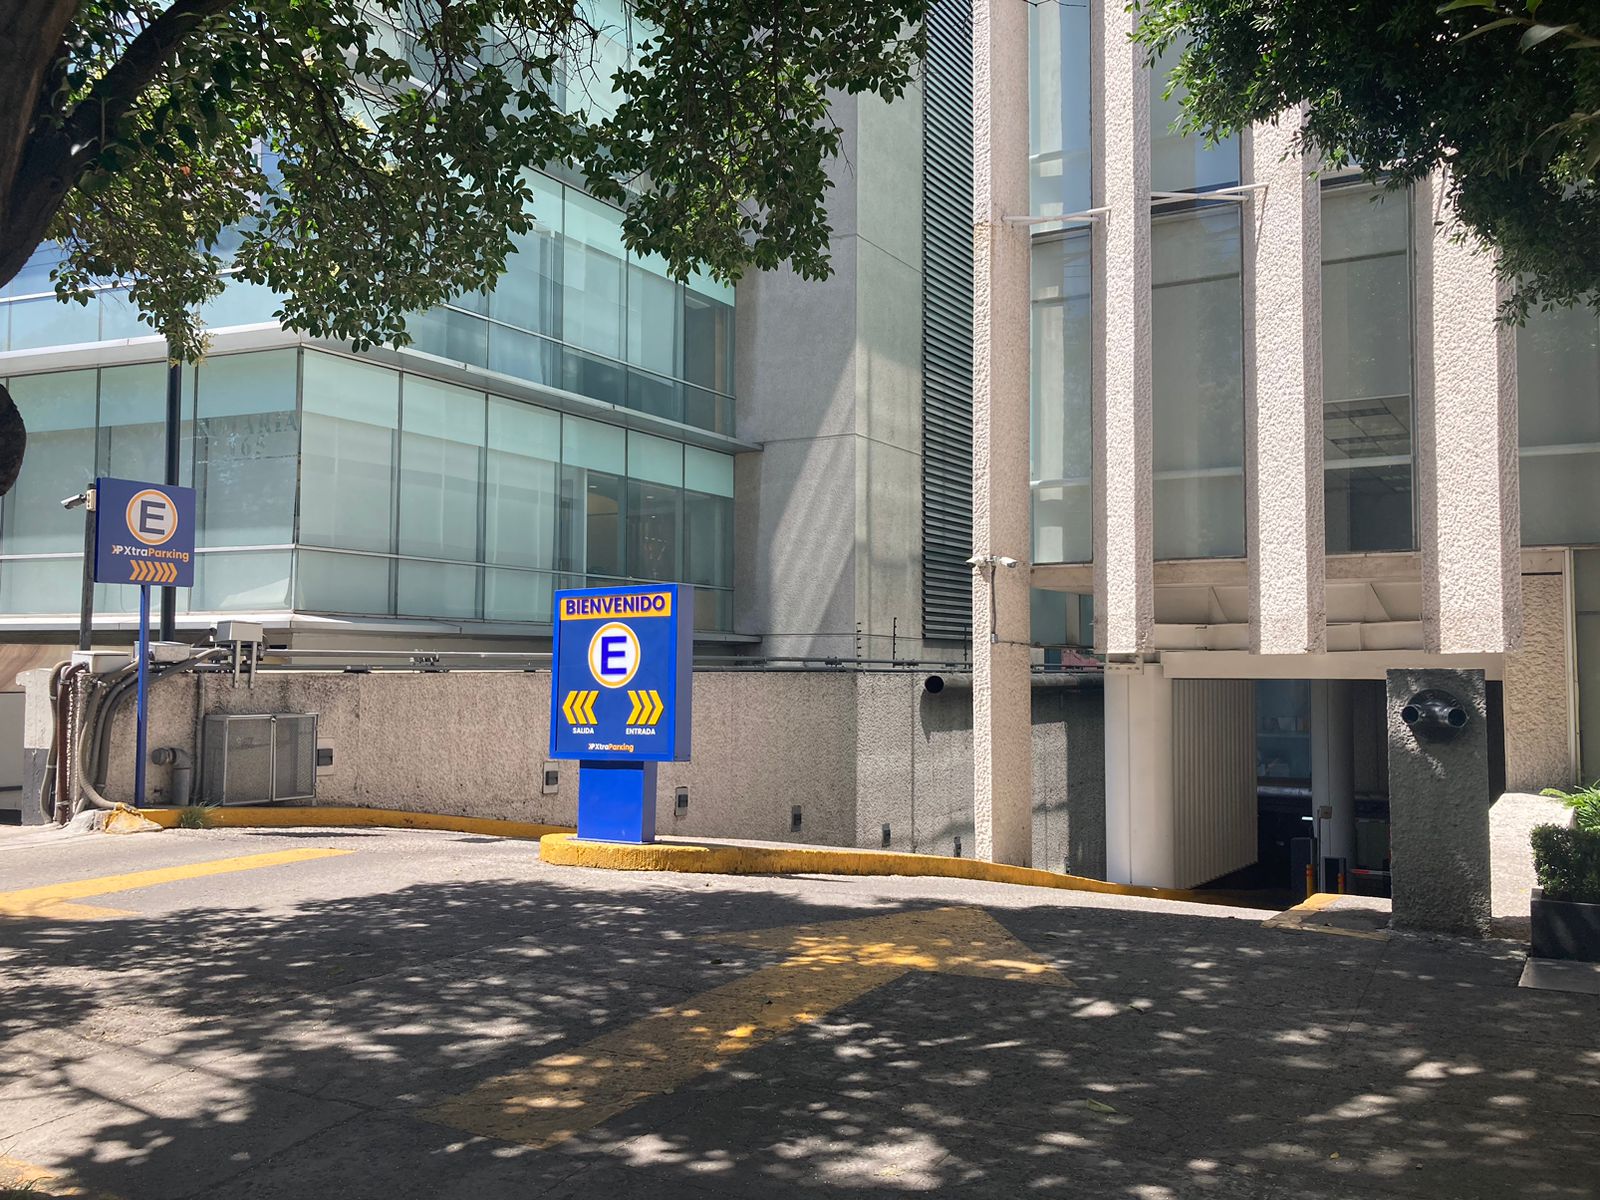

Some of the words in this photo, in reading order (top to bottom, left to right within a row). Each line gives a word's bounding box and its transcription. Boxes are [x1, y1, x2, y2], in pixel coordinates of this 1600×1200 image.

[139, 500, 166, 535] E
[566, 595, 666, 615] BIENVENIDO
[601, 636, 627, 675] E
[572, 727, 595, 735] SALIDA
[625, 727, 656, 736] ENTRADA
